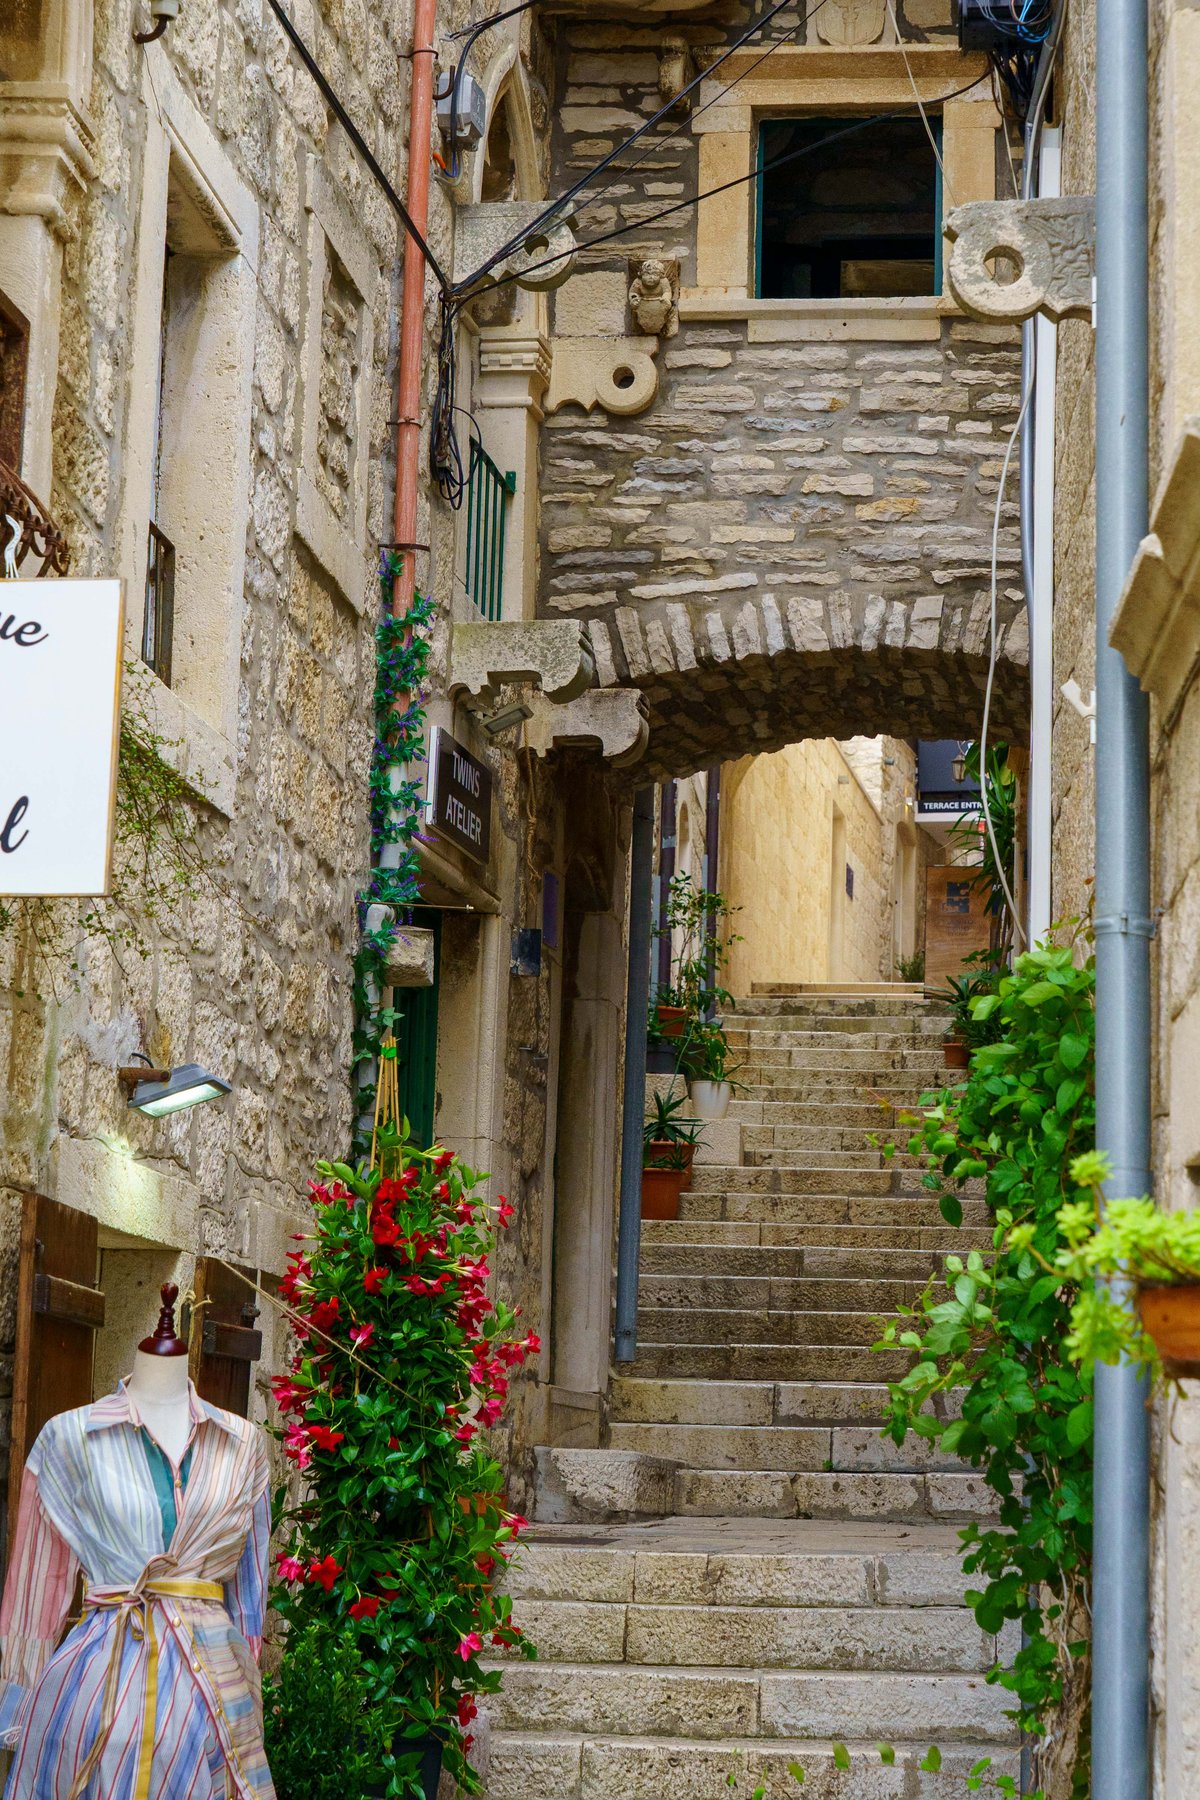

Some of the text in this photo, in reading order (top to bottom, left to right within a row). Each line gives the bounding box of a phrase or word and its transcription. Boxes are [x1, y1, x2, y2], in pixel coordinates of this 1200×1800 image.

[452, 750, 481, 799] TWINS
[445, 794, 482, 846] ATELIER
[924, 802, 959, 810] TERRACE
